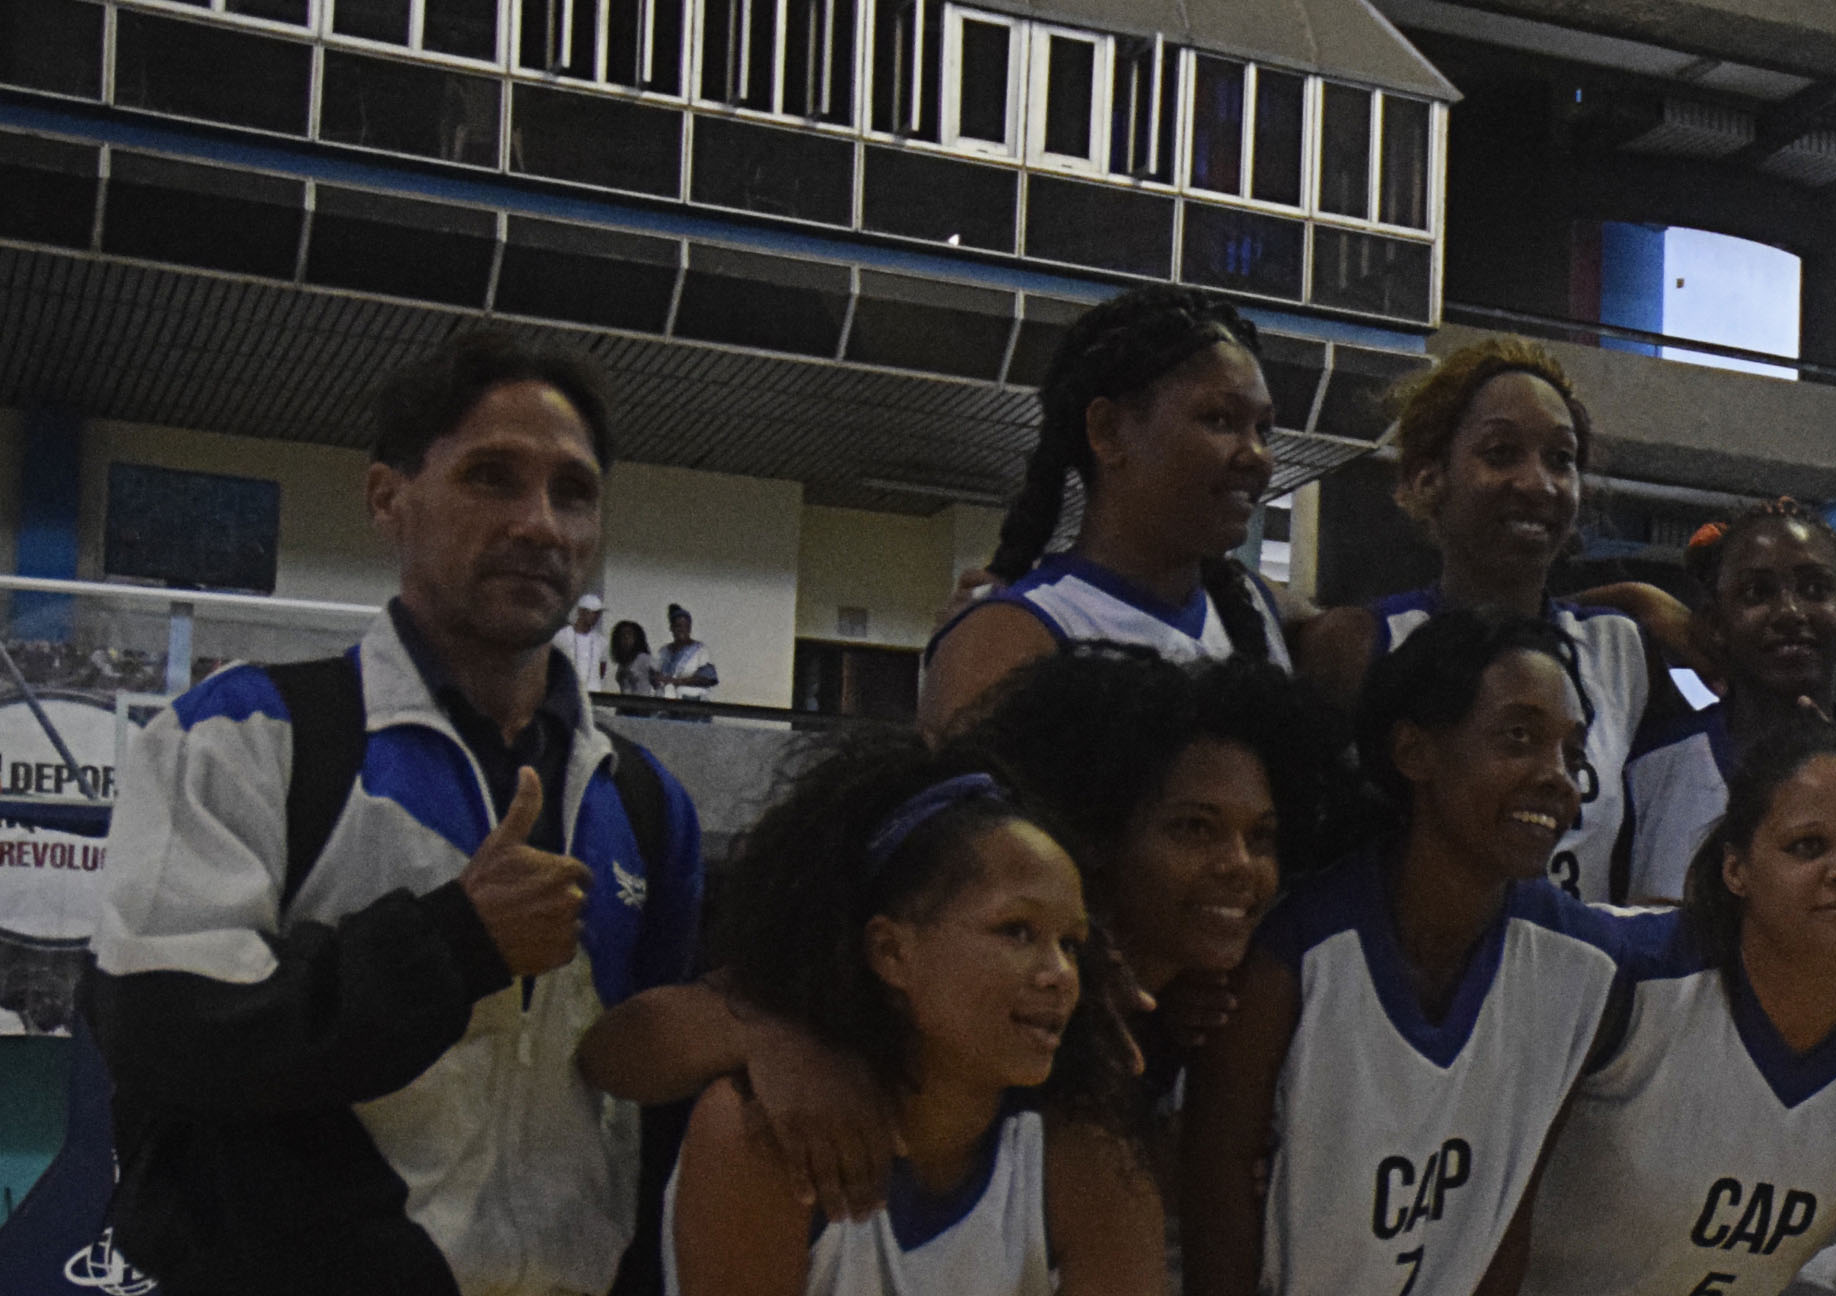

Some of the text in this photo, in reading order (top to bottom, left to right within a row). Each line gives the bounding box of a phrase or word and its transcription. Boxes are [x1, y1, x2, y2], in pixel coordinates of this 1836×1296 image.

[0, 840, 106, 872] REVOLU
[1372, 1137, 1472, 1240] CAP
[1690, 1177, 1817, 1255] CAP
